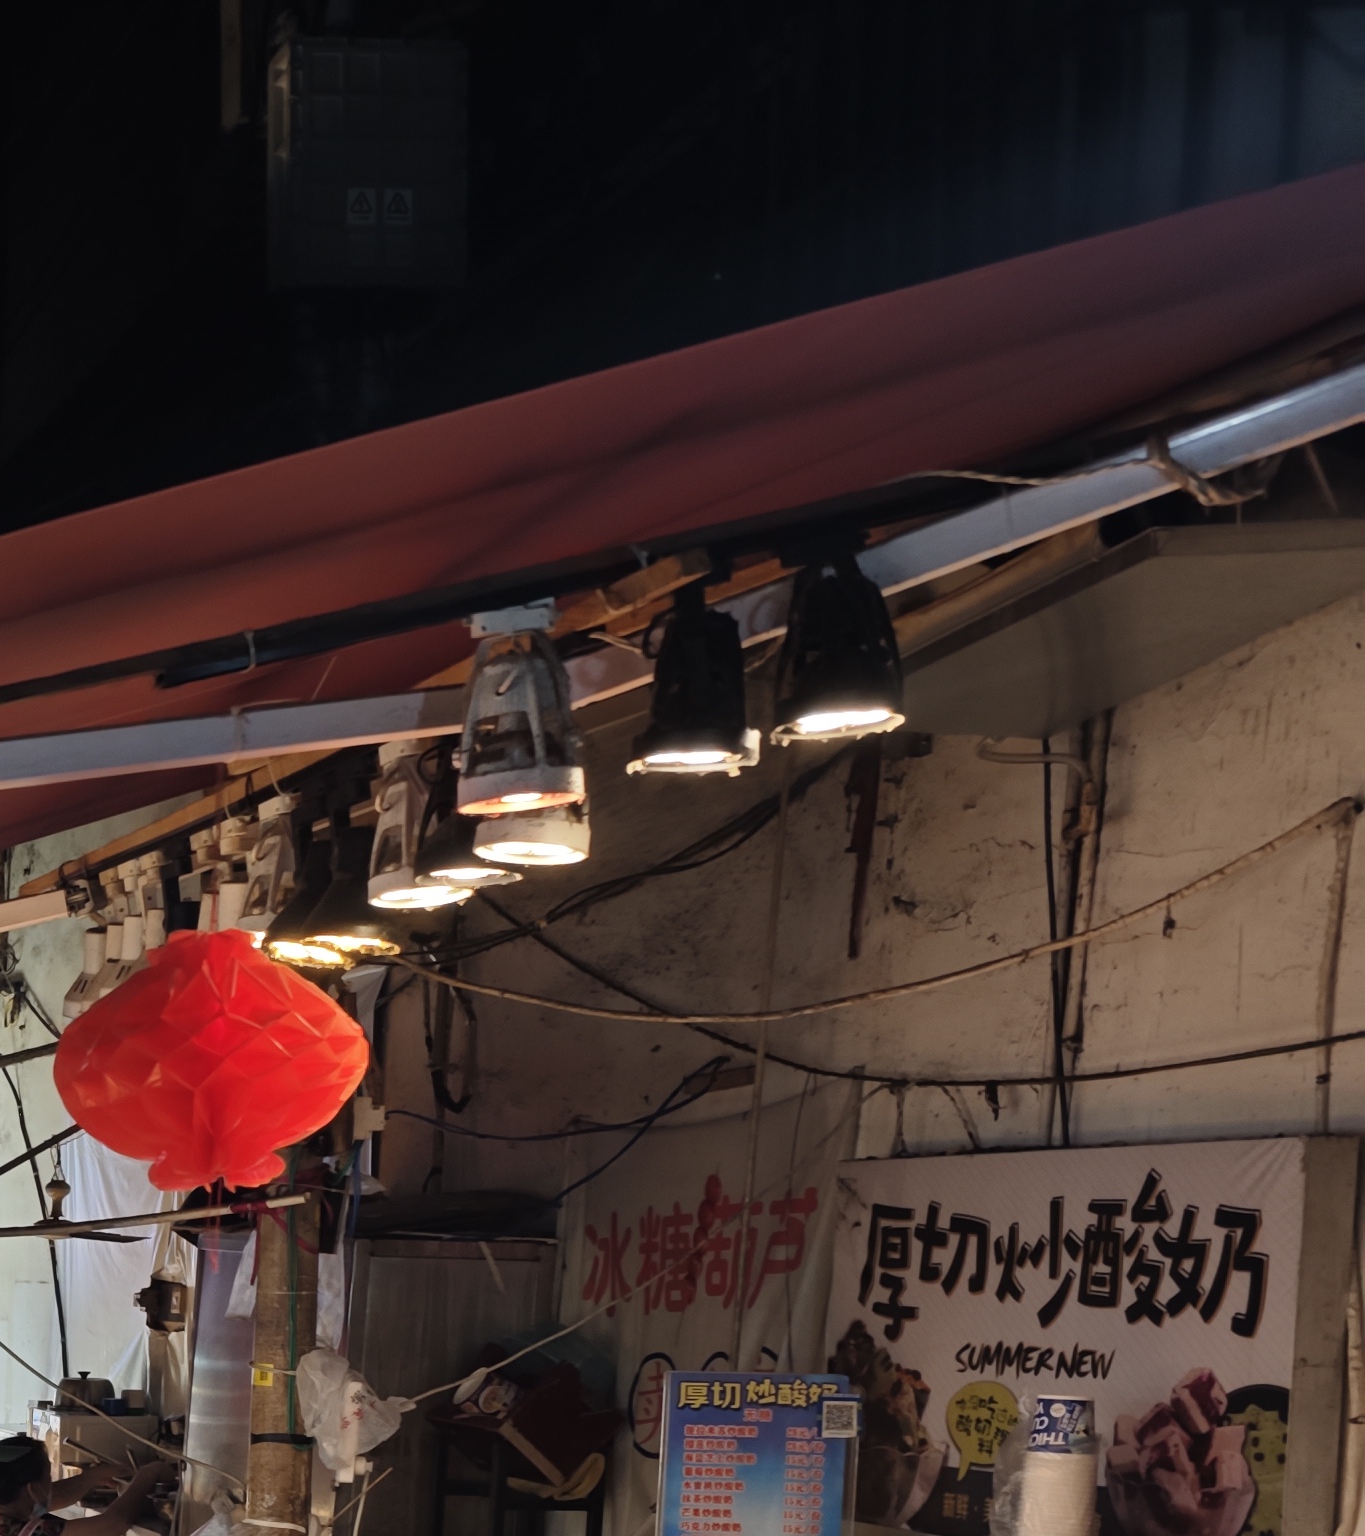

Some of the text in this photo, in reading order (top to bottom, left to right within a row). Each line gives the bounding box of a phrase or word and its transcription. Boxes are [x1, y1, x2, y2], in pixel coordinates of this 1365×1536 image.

[581, 1165, 820, 1318] 冰糖葫芦
[857, 1167, 1272, 1341] 厚切炒酸奶
